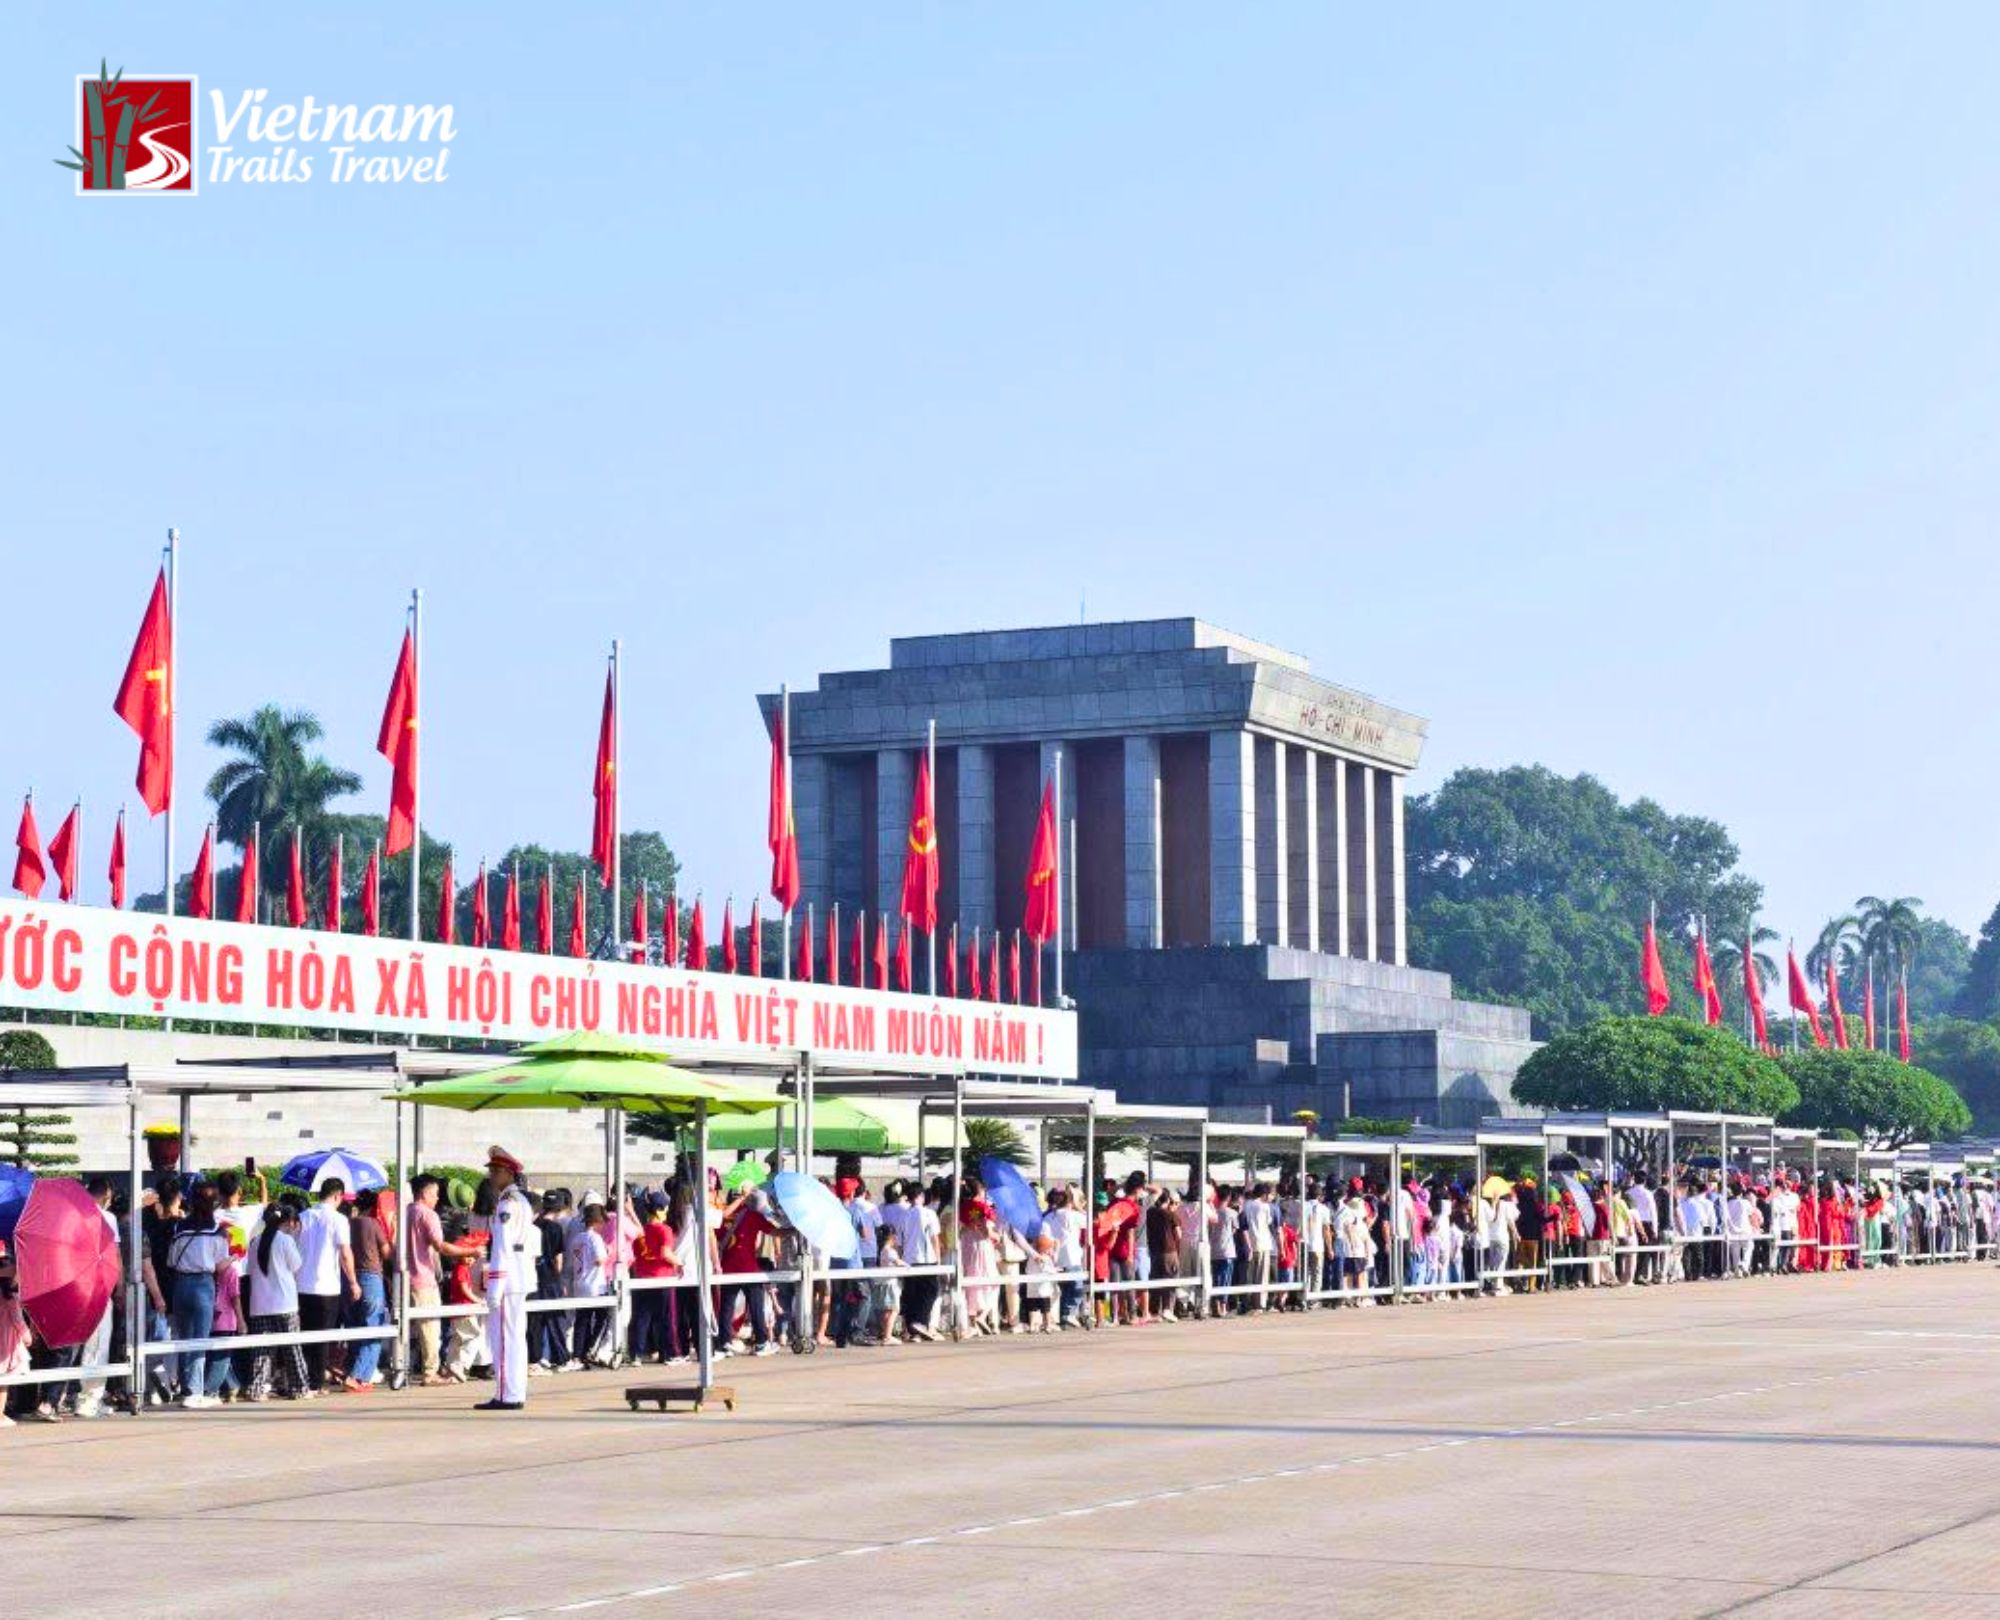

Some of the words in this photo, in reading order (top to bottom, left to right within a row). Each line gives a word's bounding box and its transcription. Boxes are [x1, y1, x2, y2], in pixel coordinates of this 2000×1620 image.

[108, 923, 244, 1012] CỘNG
[266, 941, 356, 1014] HÒA
[375, 952, 429, 1019] XÃ
[447, 958, 512, 1036] HỘI
[530, 963, 601, 1032] CHỦ
[617, 980, 719, 1041] NGHĨA
[735, 988, 798, 1052] VIỆT
[813, 1003, 875, 1050] NAM
[887, 1004, 963, 1059] MUÔN
[973, 1011, 1026, 1063] NĂM
